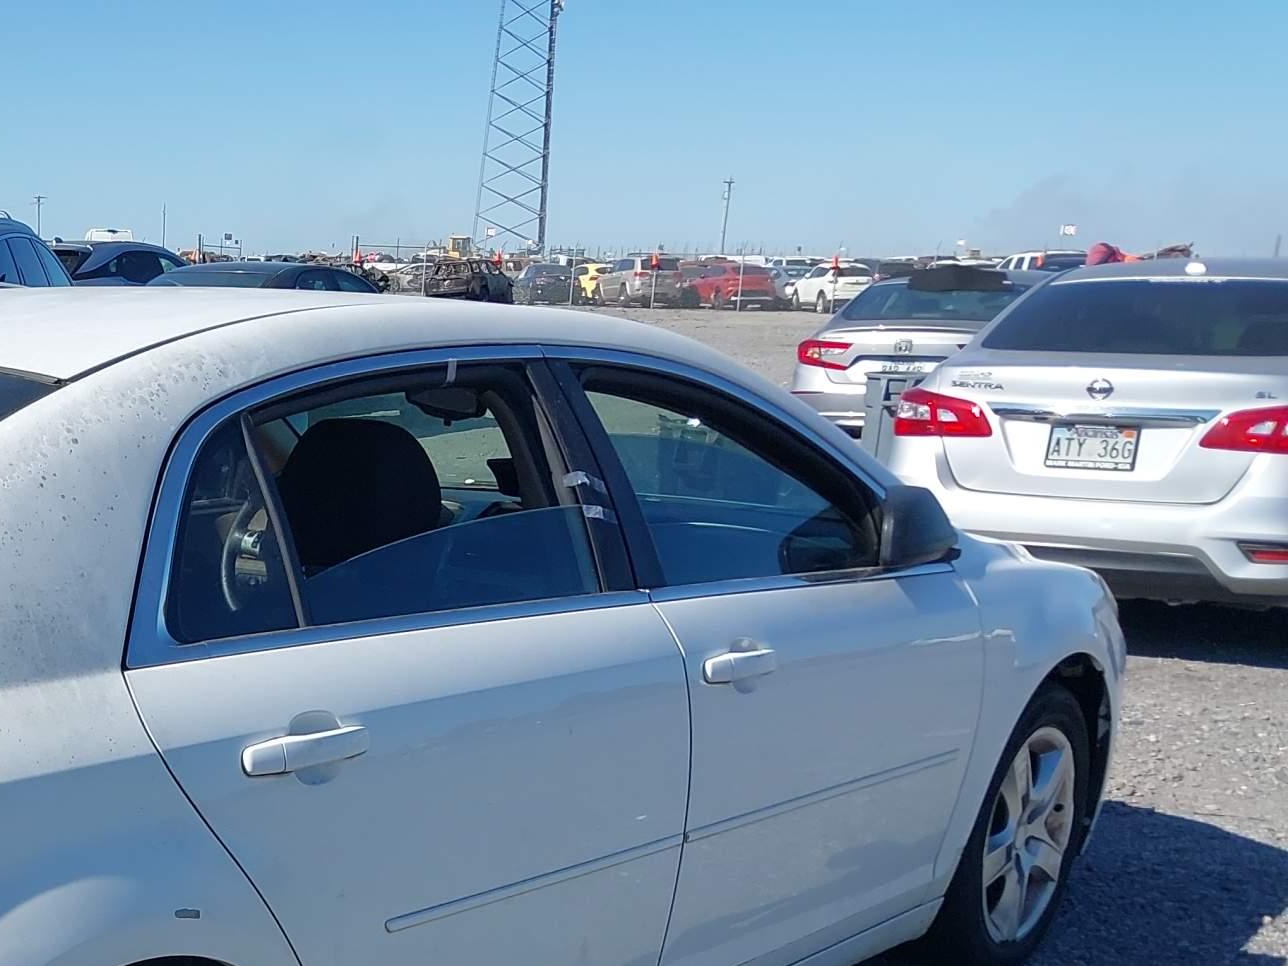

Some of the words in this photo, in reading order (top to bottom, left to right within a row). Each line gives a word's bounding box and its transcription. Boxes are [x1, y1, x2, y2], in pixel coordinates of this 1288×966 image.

[952, 380, 1004, 390] SENTRA
[1050, 437, 1087, 457] ATY
[1097, 439, 1133, 459] 36G
